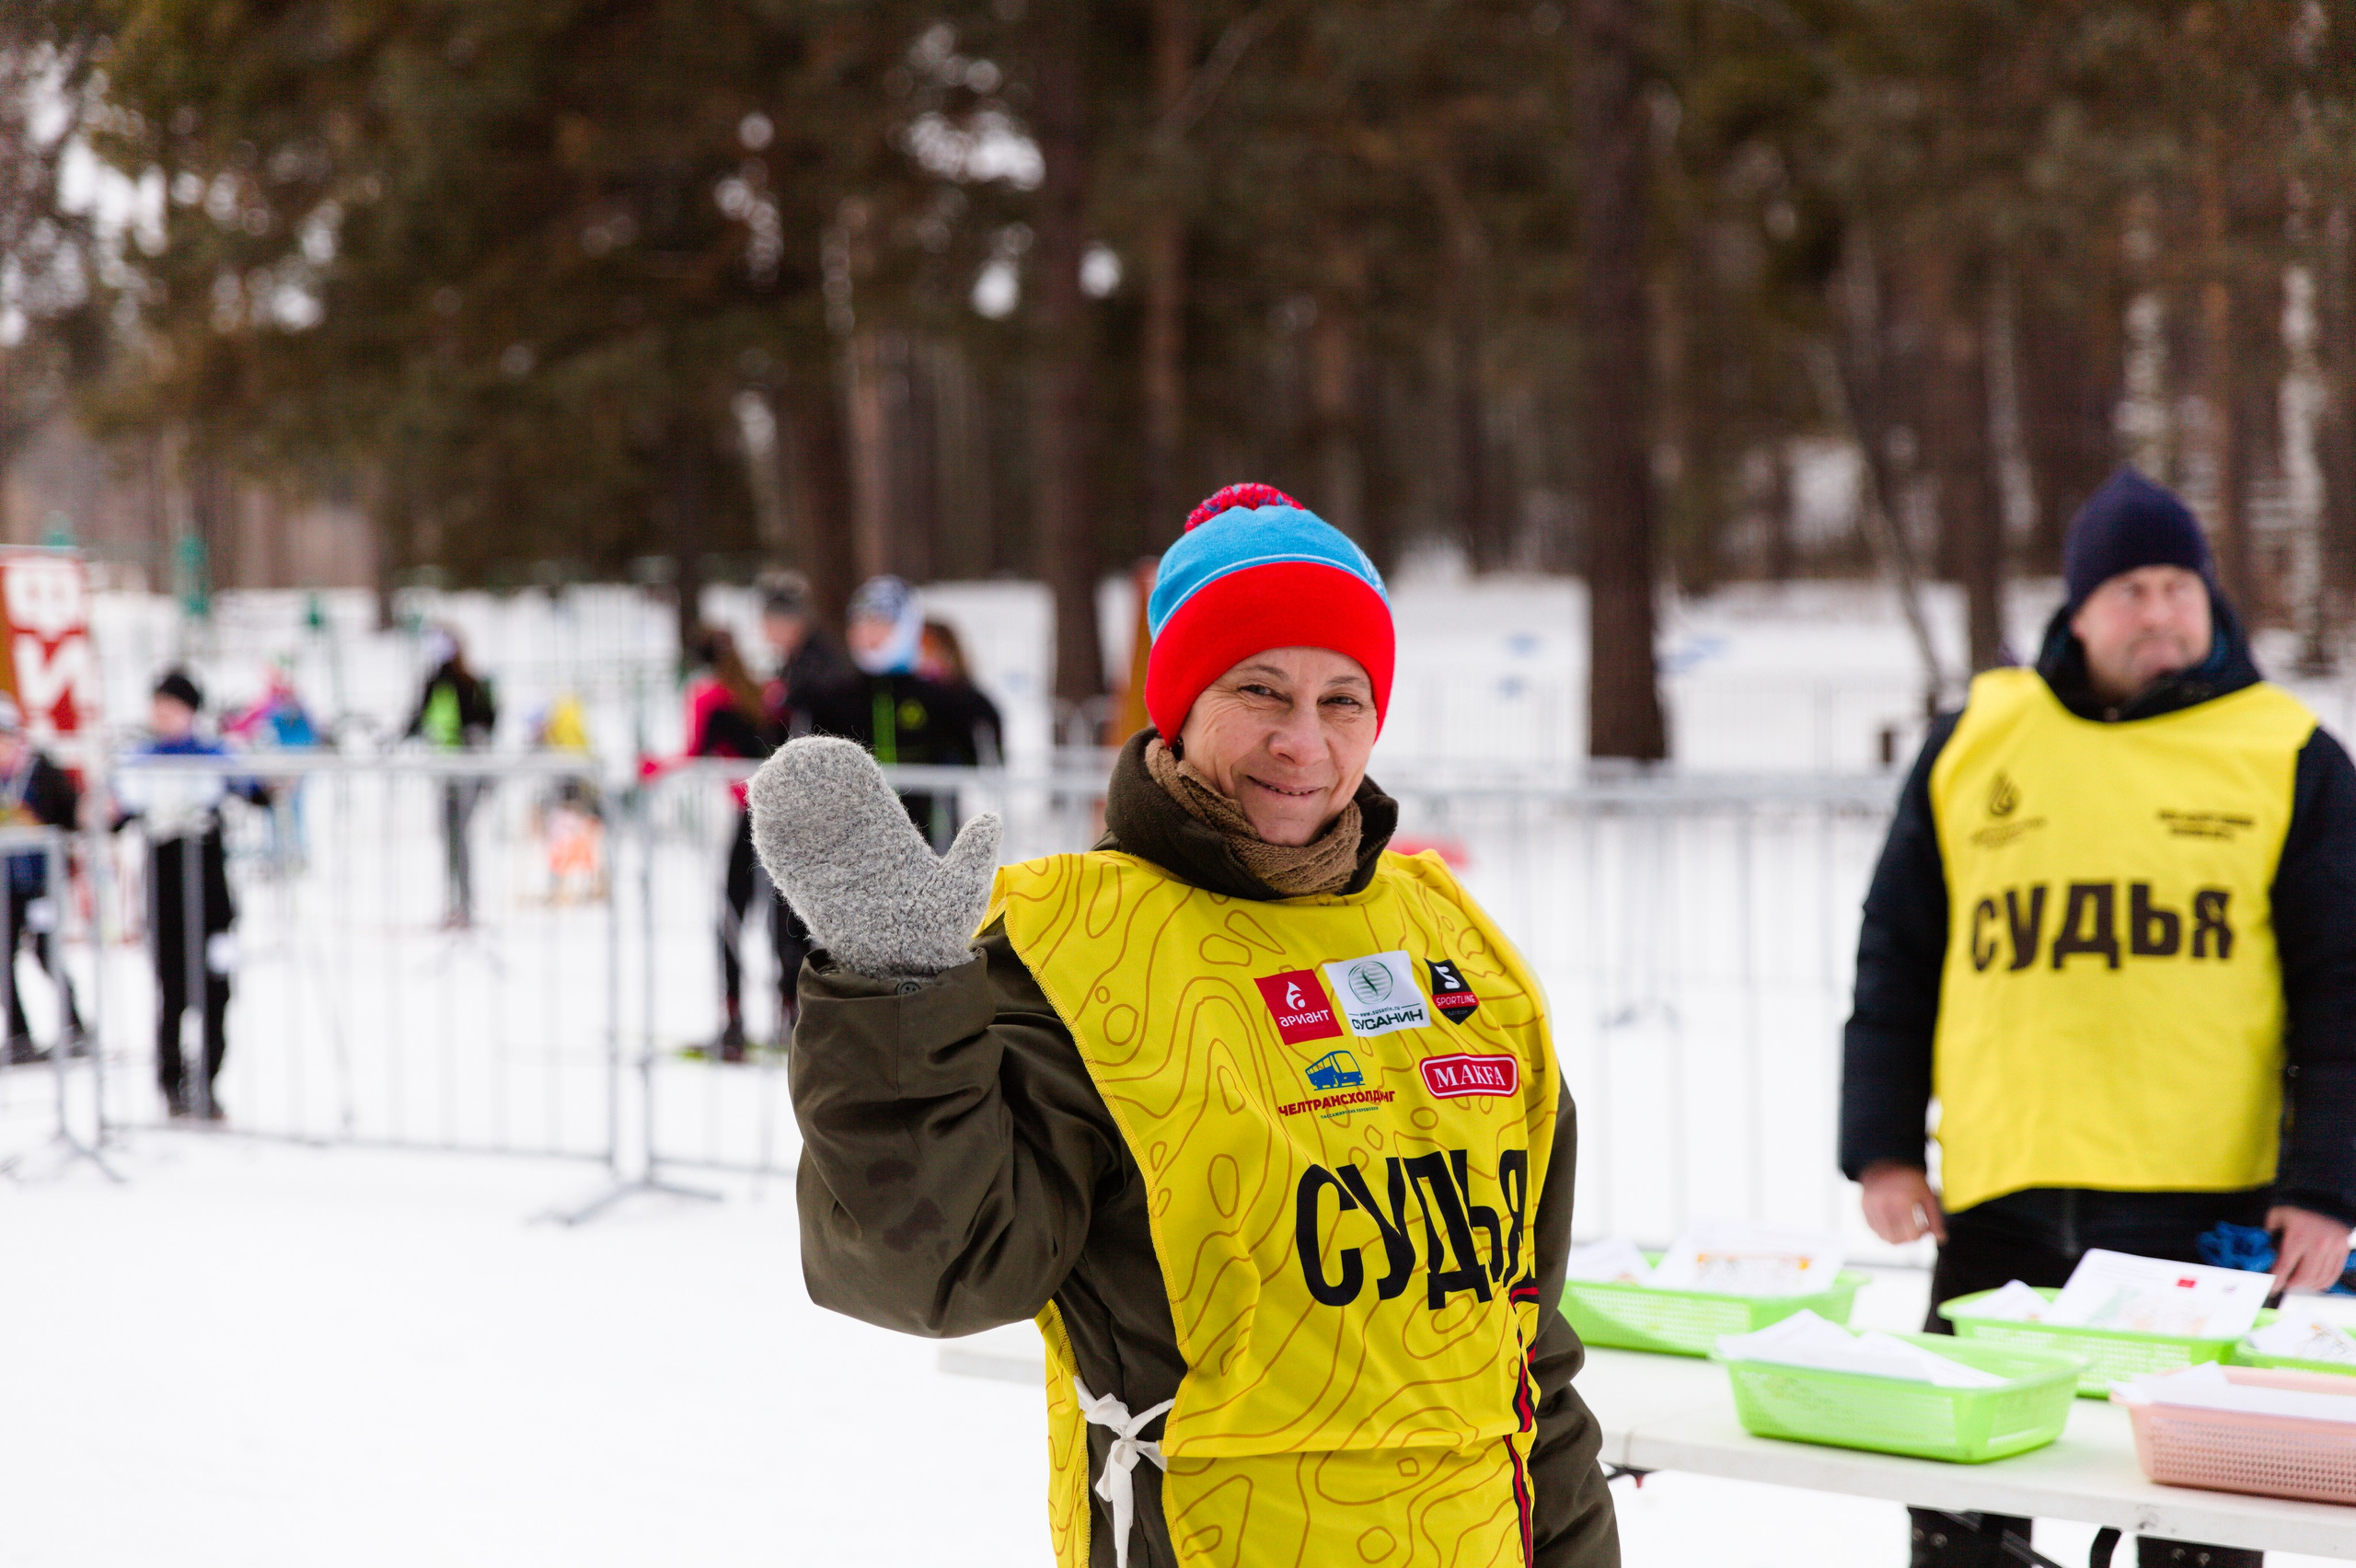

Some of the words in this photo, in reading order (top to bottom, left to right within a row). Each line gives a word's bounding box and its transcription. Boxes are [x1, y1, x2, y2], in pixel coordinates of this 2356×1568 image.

[1973, 883, 2234, 973] СУДЬЯ
[1436, 994, 1476, 1007] SPORTLINE
[1351, 1009, 1424, 1030] СУСАНИН
[1432, 1064, 1507, 1088] MAKFA
[1296, 1147, 1533, 1310] СУДЬЯ
